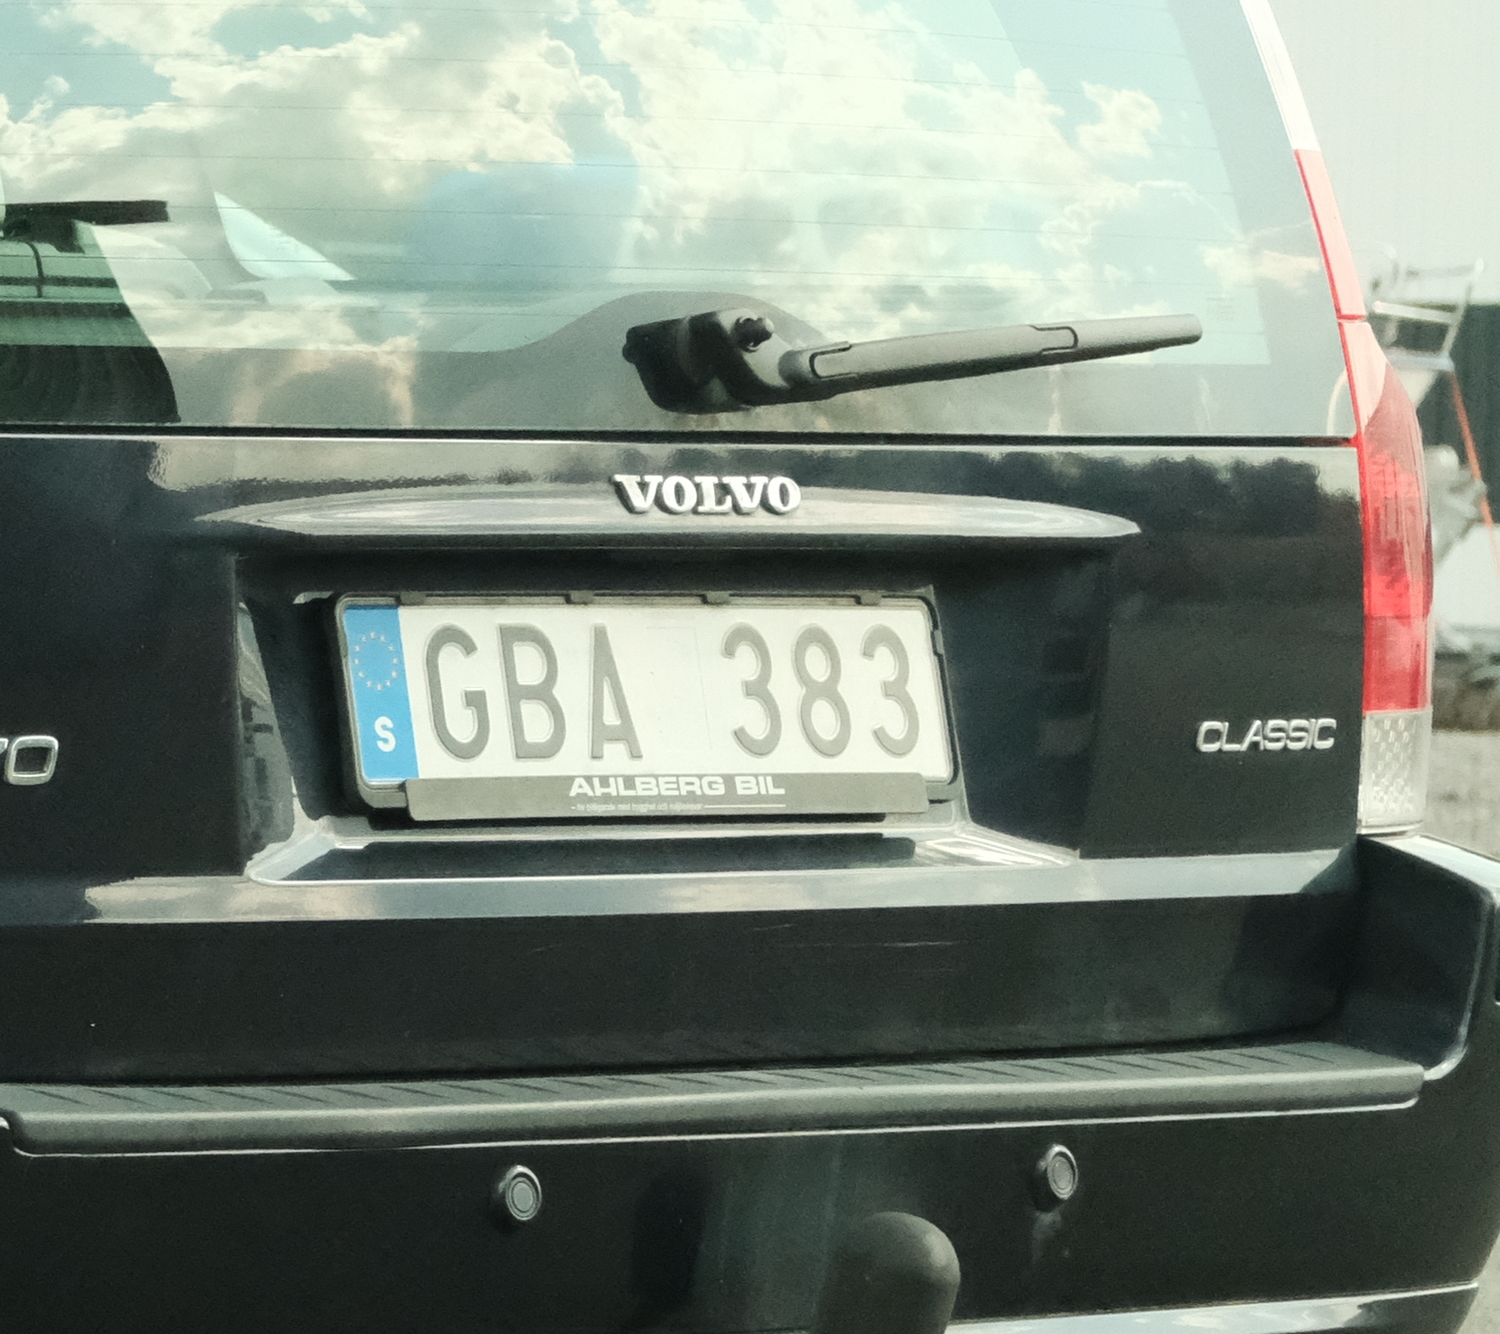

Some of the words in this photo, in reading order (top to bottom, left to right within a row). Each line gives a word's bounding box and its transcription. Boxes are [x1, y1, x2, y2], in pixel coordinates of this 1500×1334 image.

[614, 474, 803, 516] VOLVO
[424, 624, 644, 762] GBA
[720, 624, 921, 759] 383
[375, 716, 397, 752] S
[1196, 718, 1337, 752] CLASSIC
[569, 776, 726, 797] AHLBERG
[734, 776, 786, 796] BIL
